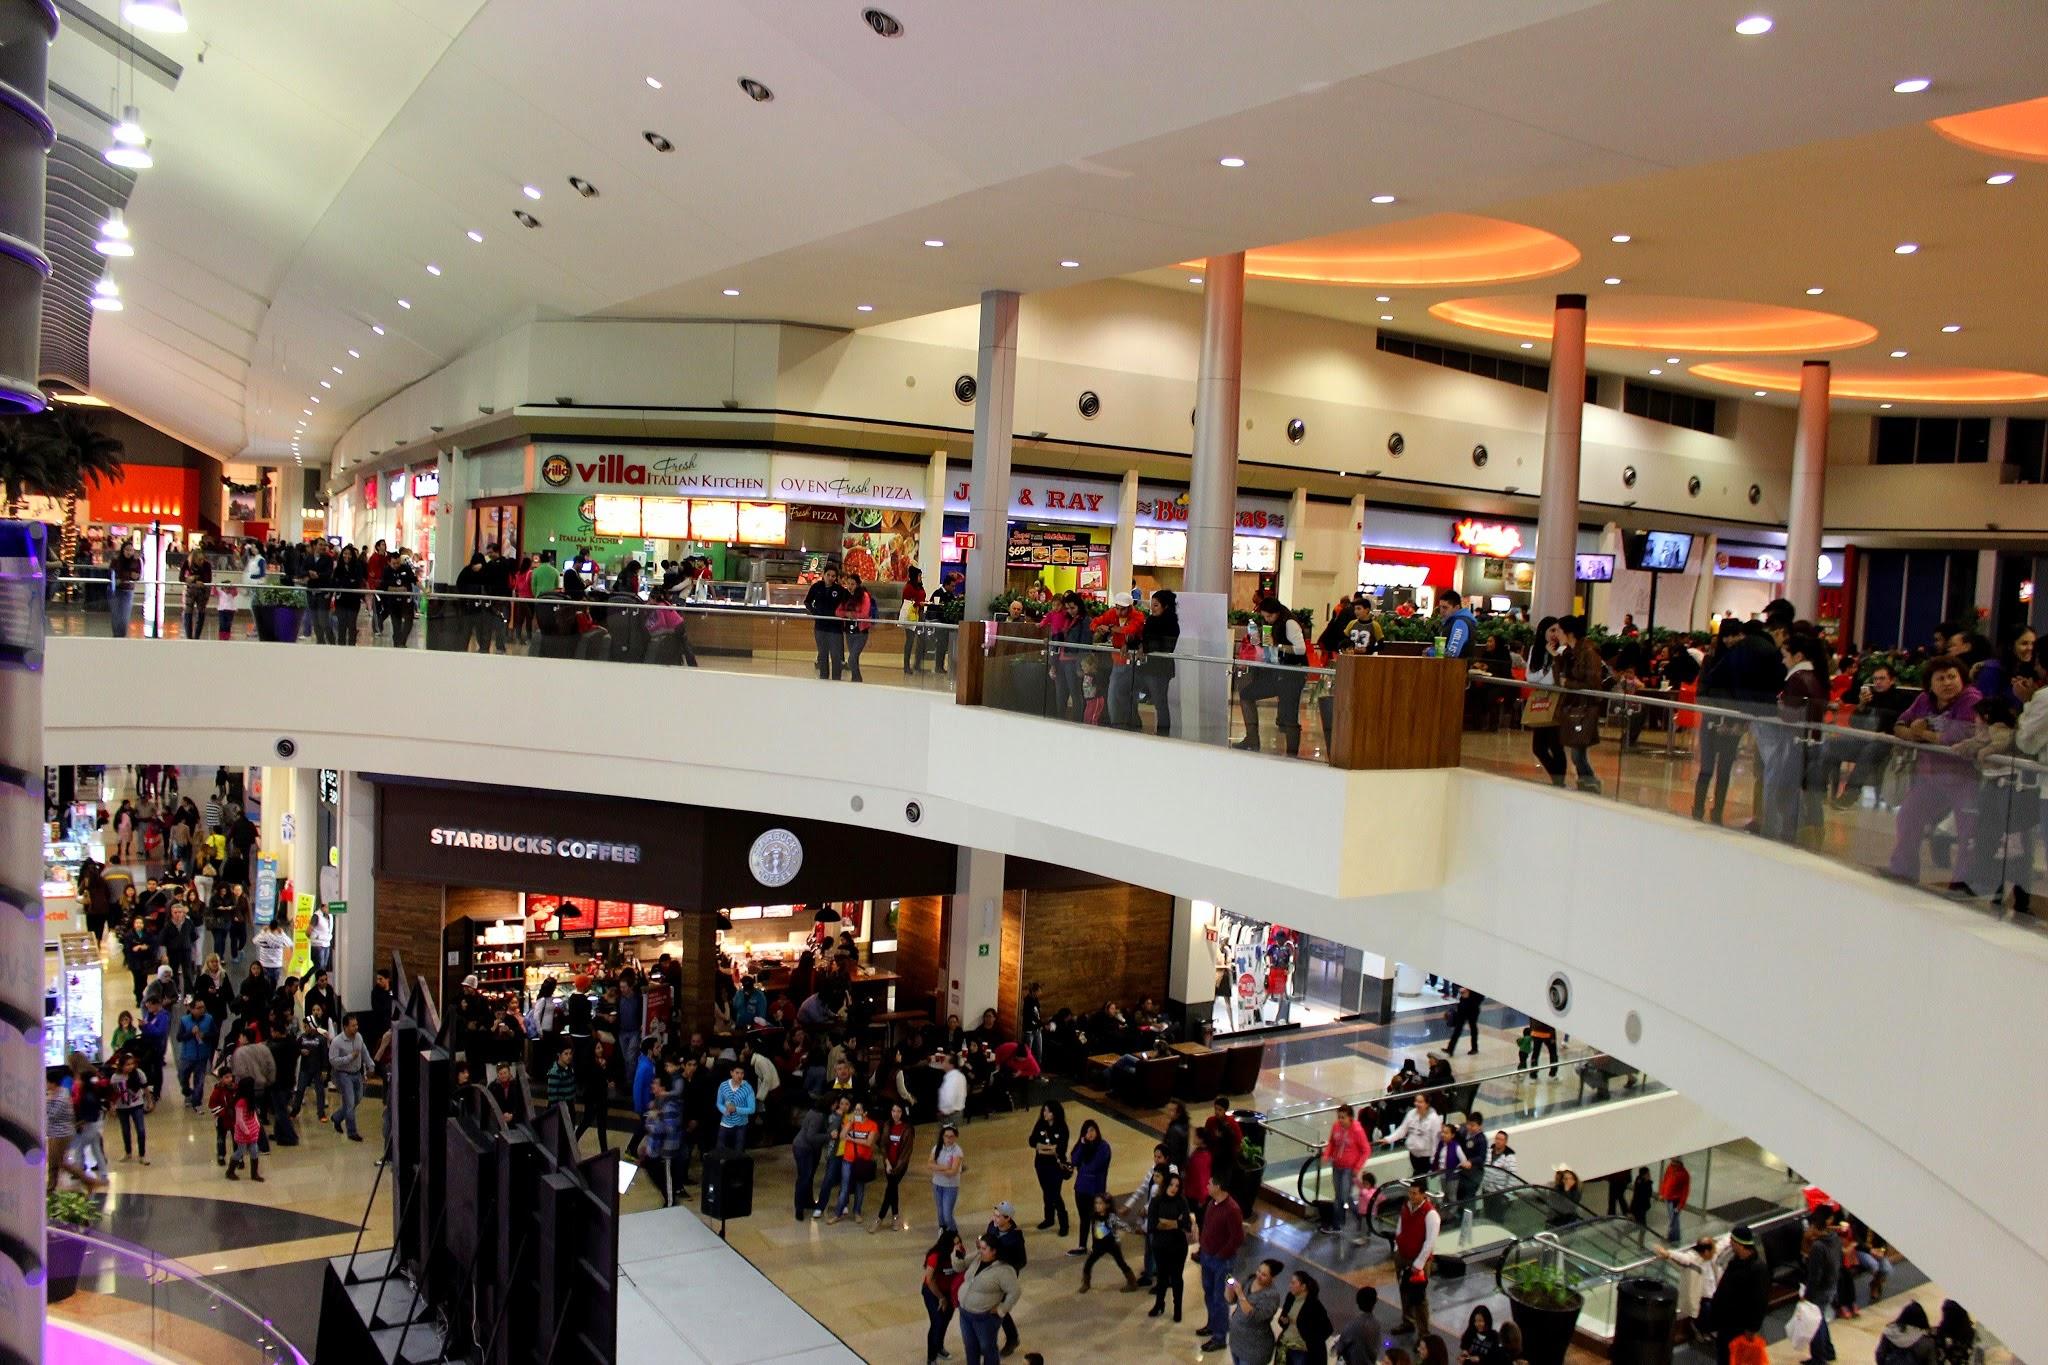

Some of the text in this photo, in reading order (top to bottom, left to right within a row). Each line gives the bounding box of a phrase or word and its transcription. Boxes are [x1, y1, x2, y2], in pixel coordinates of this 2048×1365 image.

[575, 453, 698, 485] villa Fresh
[647, 472, 764, 489] ITALIAN KITCHEN
[781, 477, 913, 501] OVEN Fresh PIZZA
[1046, 490, 1104, 511] RAY
[812, 510, 838, 520] PIZZA
[430, 827, 641, 863] STARBUCKS COFFEE
